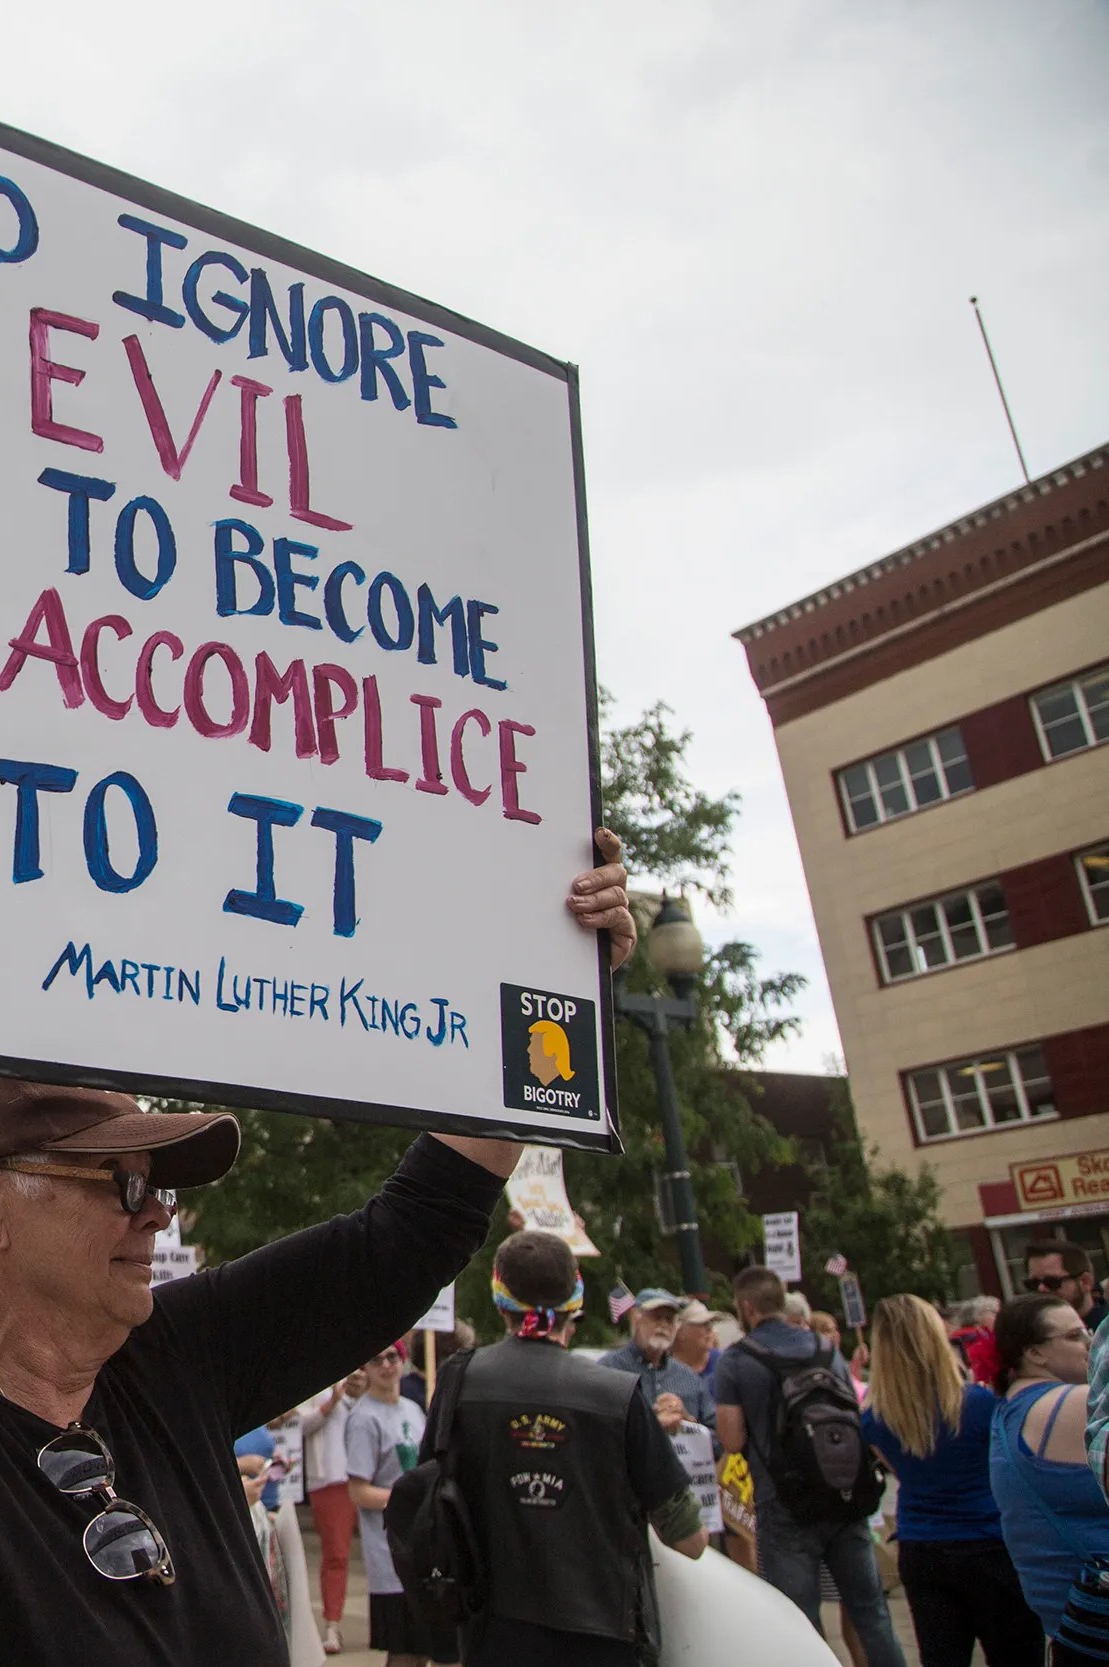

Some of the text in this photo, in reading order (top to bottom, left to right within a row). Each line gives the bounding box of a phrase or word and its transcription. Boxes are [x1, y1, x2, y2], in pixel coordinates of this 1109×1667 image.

[112, 213, 458, 429] IGNORE
[29, 307, 355, 532] EVIL
[37, 467, 176, 600] TO
[210, 517, 507, 691] BECOME
[223, 790, 383, 937] IT
[42, 941, 200, 1006] MARTIN
[216, 956, 330, 1021] LUTHER
[340, 976, 421, 1041] KING
[520, 992, 577, 1023] STOP
[524, 1085, 581, 1108] BIGOTRY
[537, 1414, 566, 1432] ARMY
[510, 1472, 563, 1490] POW MIA
